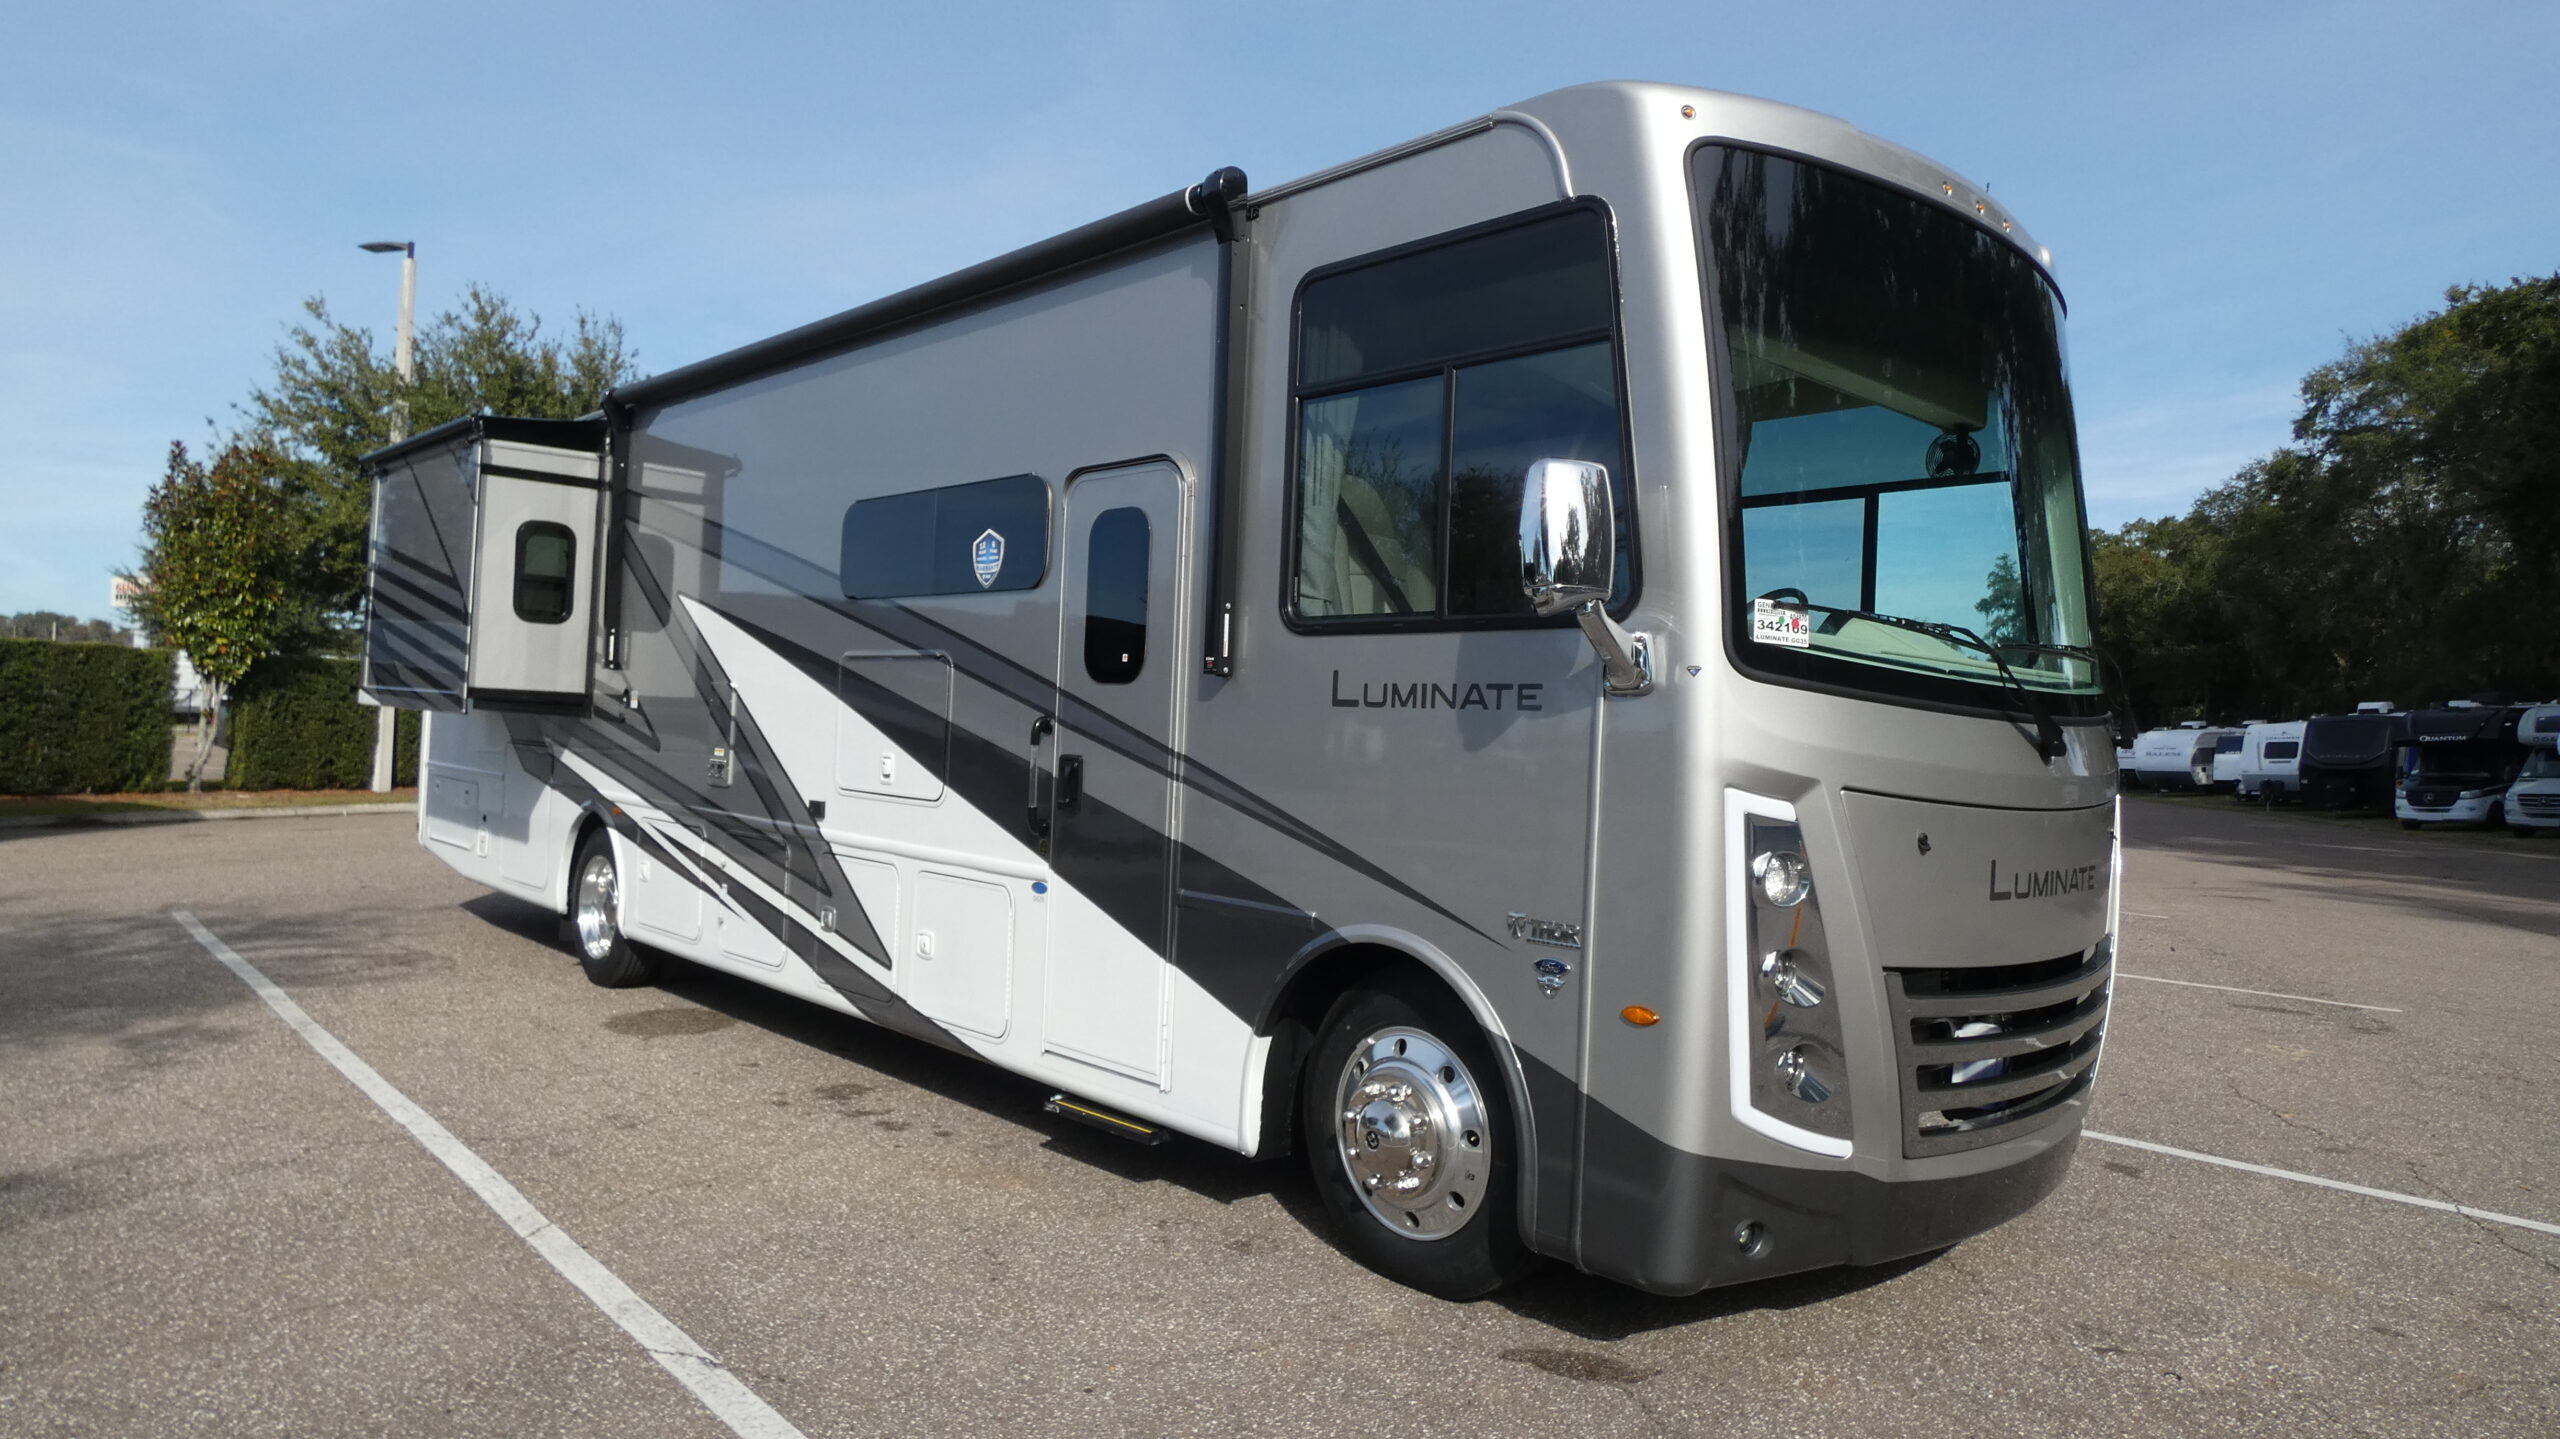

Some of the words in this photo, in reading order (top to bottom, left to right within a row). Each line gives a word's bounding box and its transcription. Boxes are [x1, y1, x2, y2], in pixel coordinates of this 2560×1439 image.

[1756, 634, 1790, 643] LUMINATE
[1332, 669, 1544, 711] LUMINATE
[1989, 859, 2096, 901] LUMINATE
